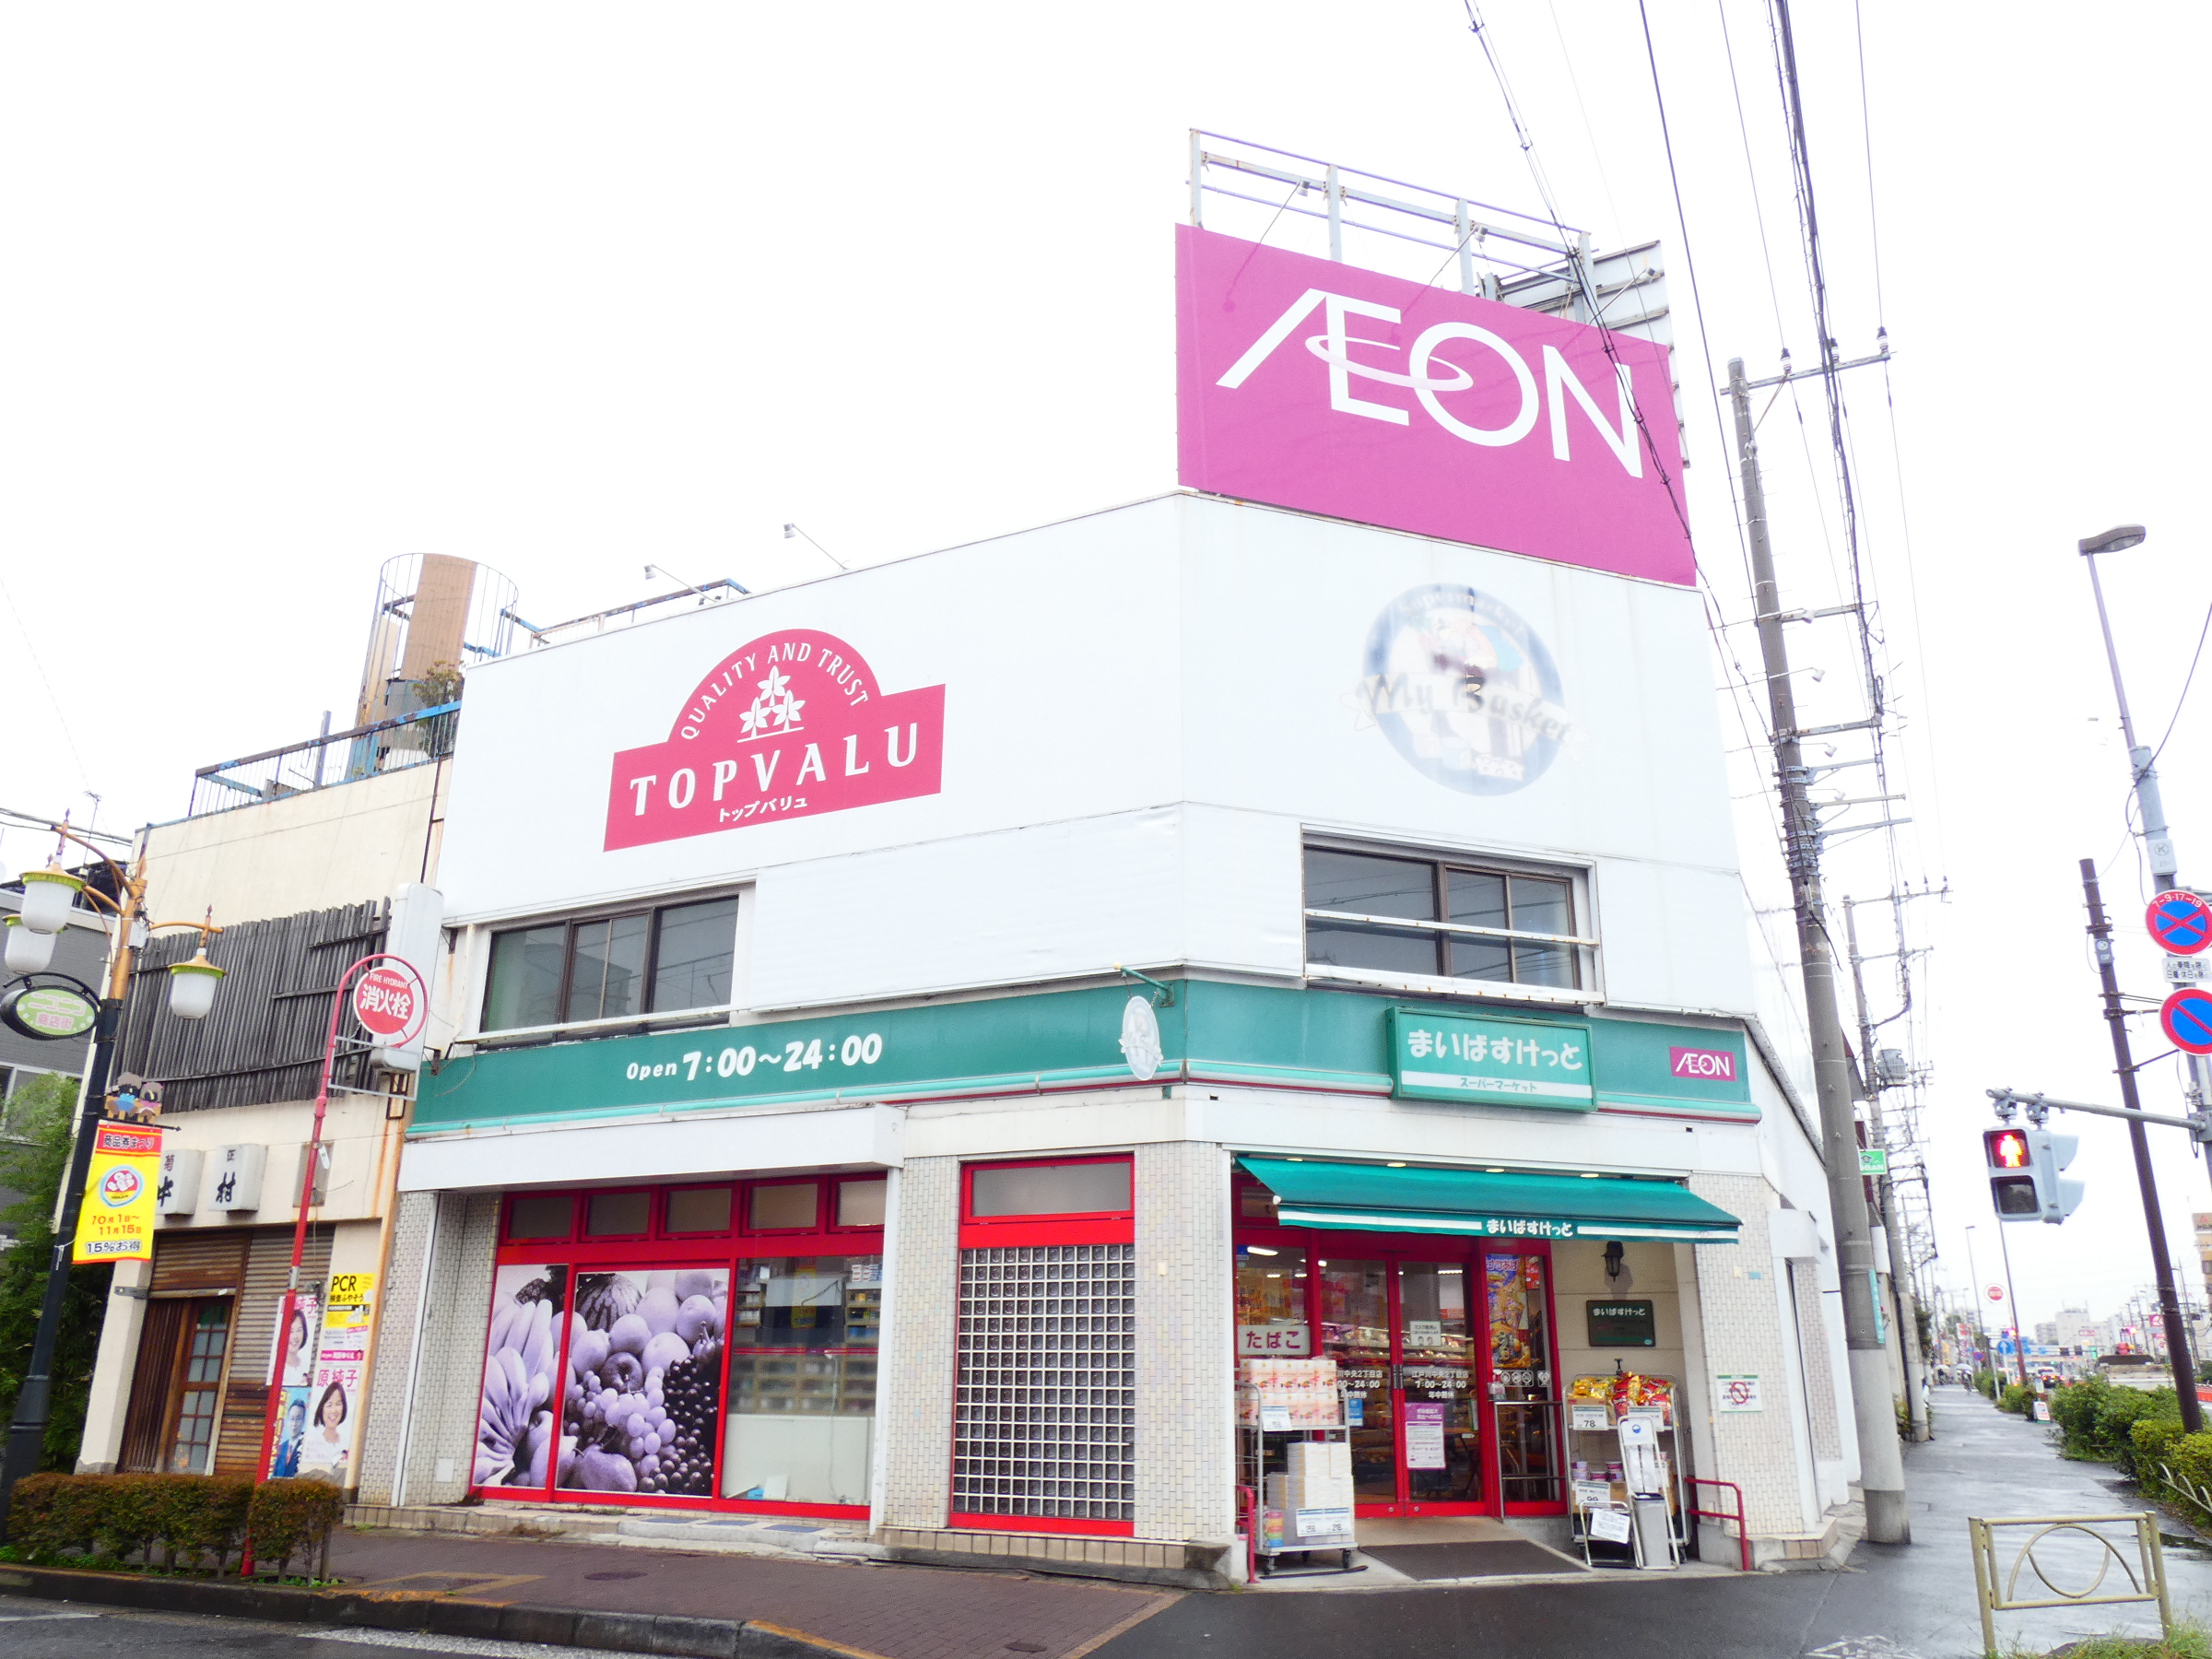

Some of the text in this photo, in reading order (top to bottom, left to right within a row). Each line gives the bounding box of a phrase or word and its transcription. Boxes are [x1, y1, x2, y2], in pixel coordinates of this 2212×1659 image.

[1216, 288, 1643, 478] AEON
[680, 641, 869, 740] QUALITY AND TRUST
[629, 722, 919, 817] TOPVALU
[719, 795, 808, 823] トップバリュ
[370, 972, 408, 990] FIRE HYDRANT
[29, 992, 88, 1017] ニコニコ
[359, 983, 412, 1020] 消火栓
[35, 1012, 75, 1031] 商店街
[1407, 1029, 1583, 1071] まいばすけっと
[627, 1063, 677, 1081] Open
[1676, 1053, 1731, 1077] AEON
[1460, 1077, 1537, 1093] スーパーマーケット
[102, 1133, 155, 1150] 商品券まつり
[99, 1224, 142, 1236] 11月15日
[1487, 1218, 1574, 1237] まいばすけっと
[87, 1240, 142, 1255] 15%お得
[331, 1275, 357, 1292] PCR
[330, 1293, 364, 1303] 検査ふやそう
[1593, 1307, 1646, 1317] まいばすけっと
[1246, 1330, 1301, 1349] たばこ
[317, 1369, 359, 1388] 原純子
[1583, 1419, 1596, 1428] 78
